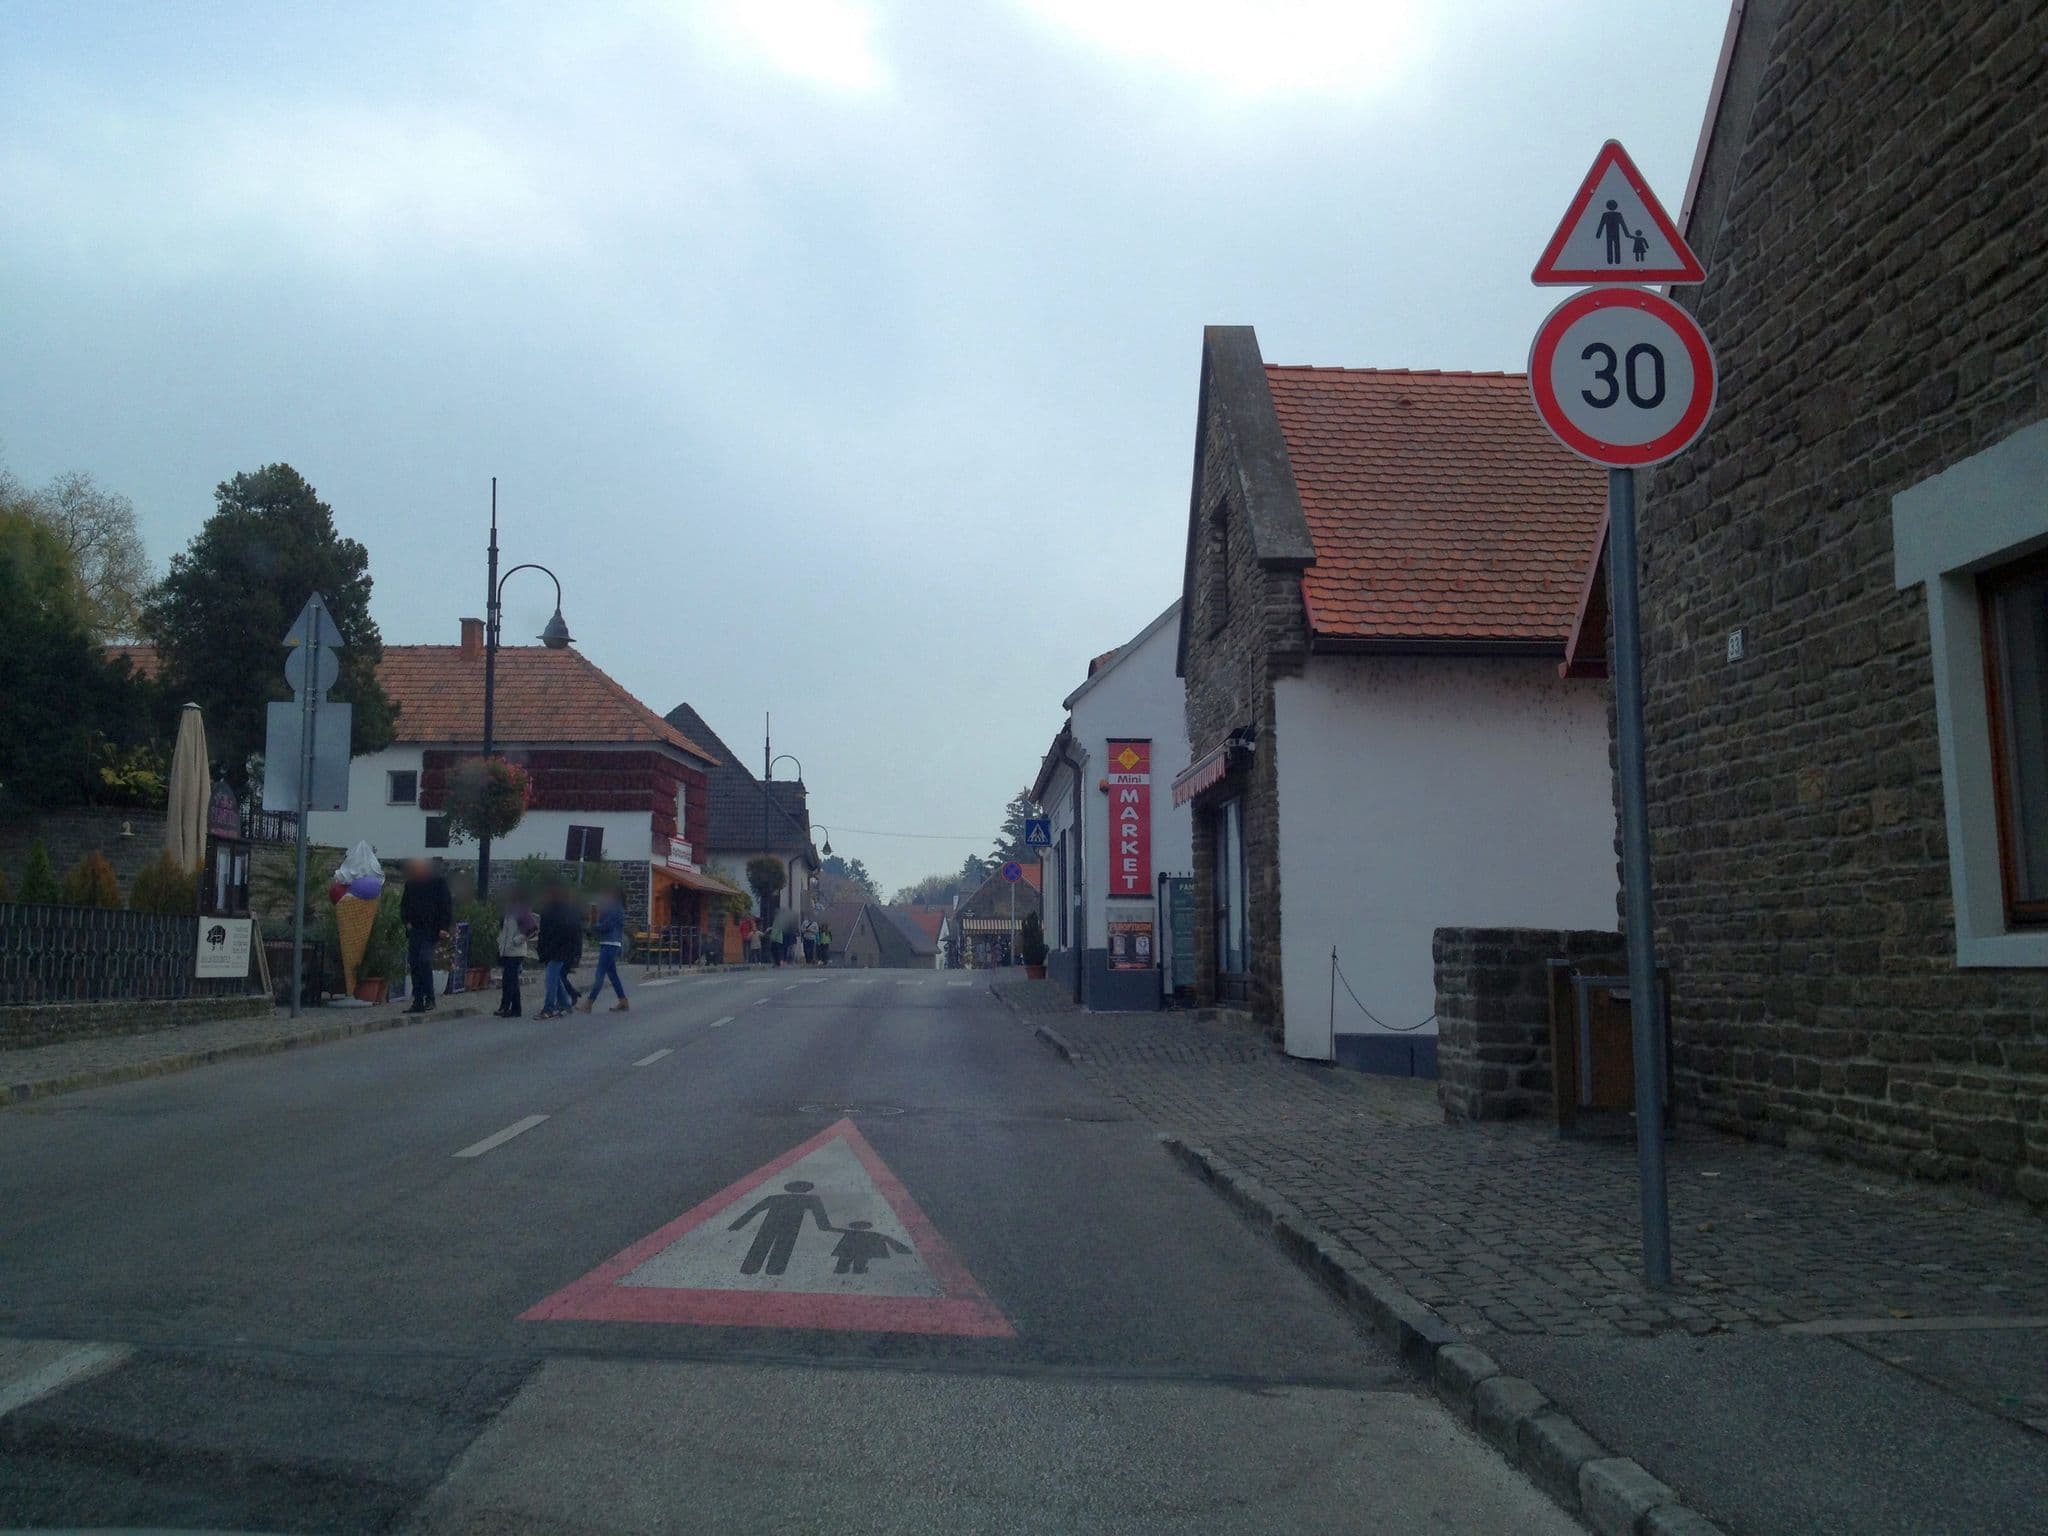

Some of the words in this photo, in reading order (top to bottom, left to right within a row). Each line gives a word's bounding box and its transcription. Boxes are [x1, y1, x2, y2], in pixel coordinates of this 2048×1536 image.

[1581, 342, 1665, 409] 30
[1117, 775, 1142, 783] Mini
[1119, 788, 1139, 889] MARKET
